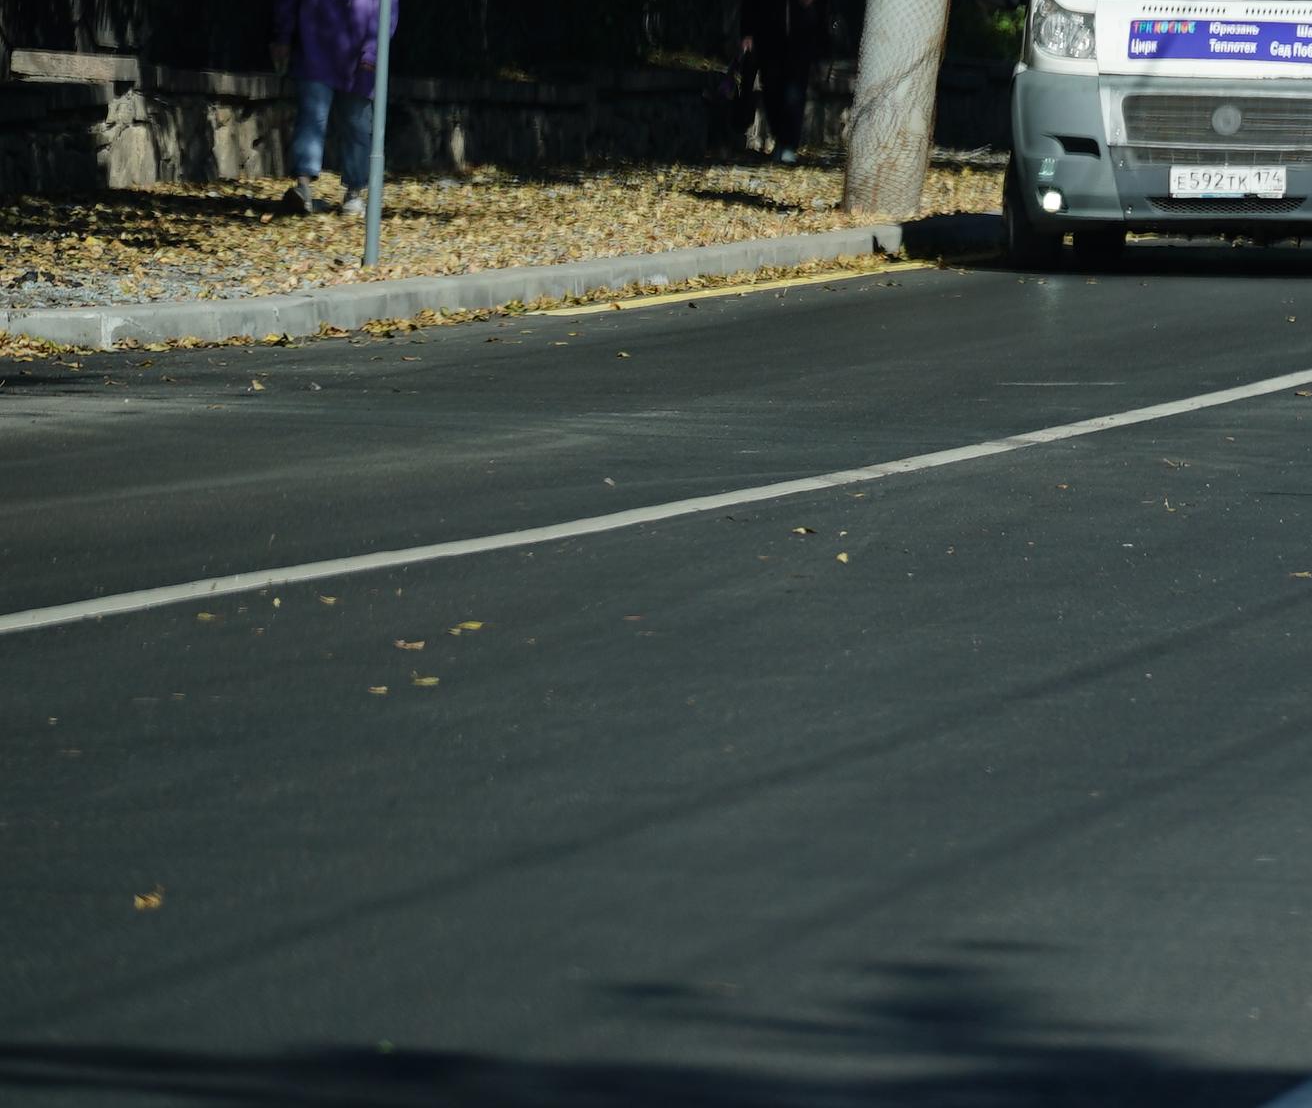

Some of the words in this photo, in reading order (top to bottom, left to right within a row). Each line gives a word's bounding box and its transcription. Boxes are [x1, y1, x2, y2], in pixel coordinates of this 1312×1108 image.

[1209, 22, 1260, 37] Юрюзань
[1131, 38, 1158, 55] Цирк
[1209, 38, 1257, 54] Теплотех
[1269, 40, 1291, 58] Сад
